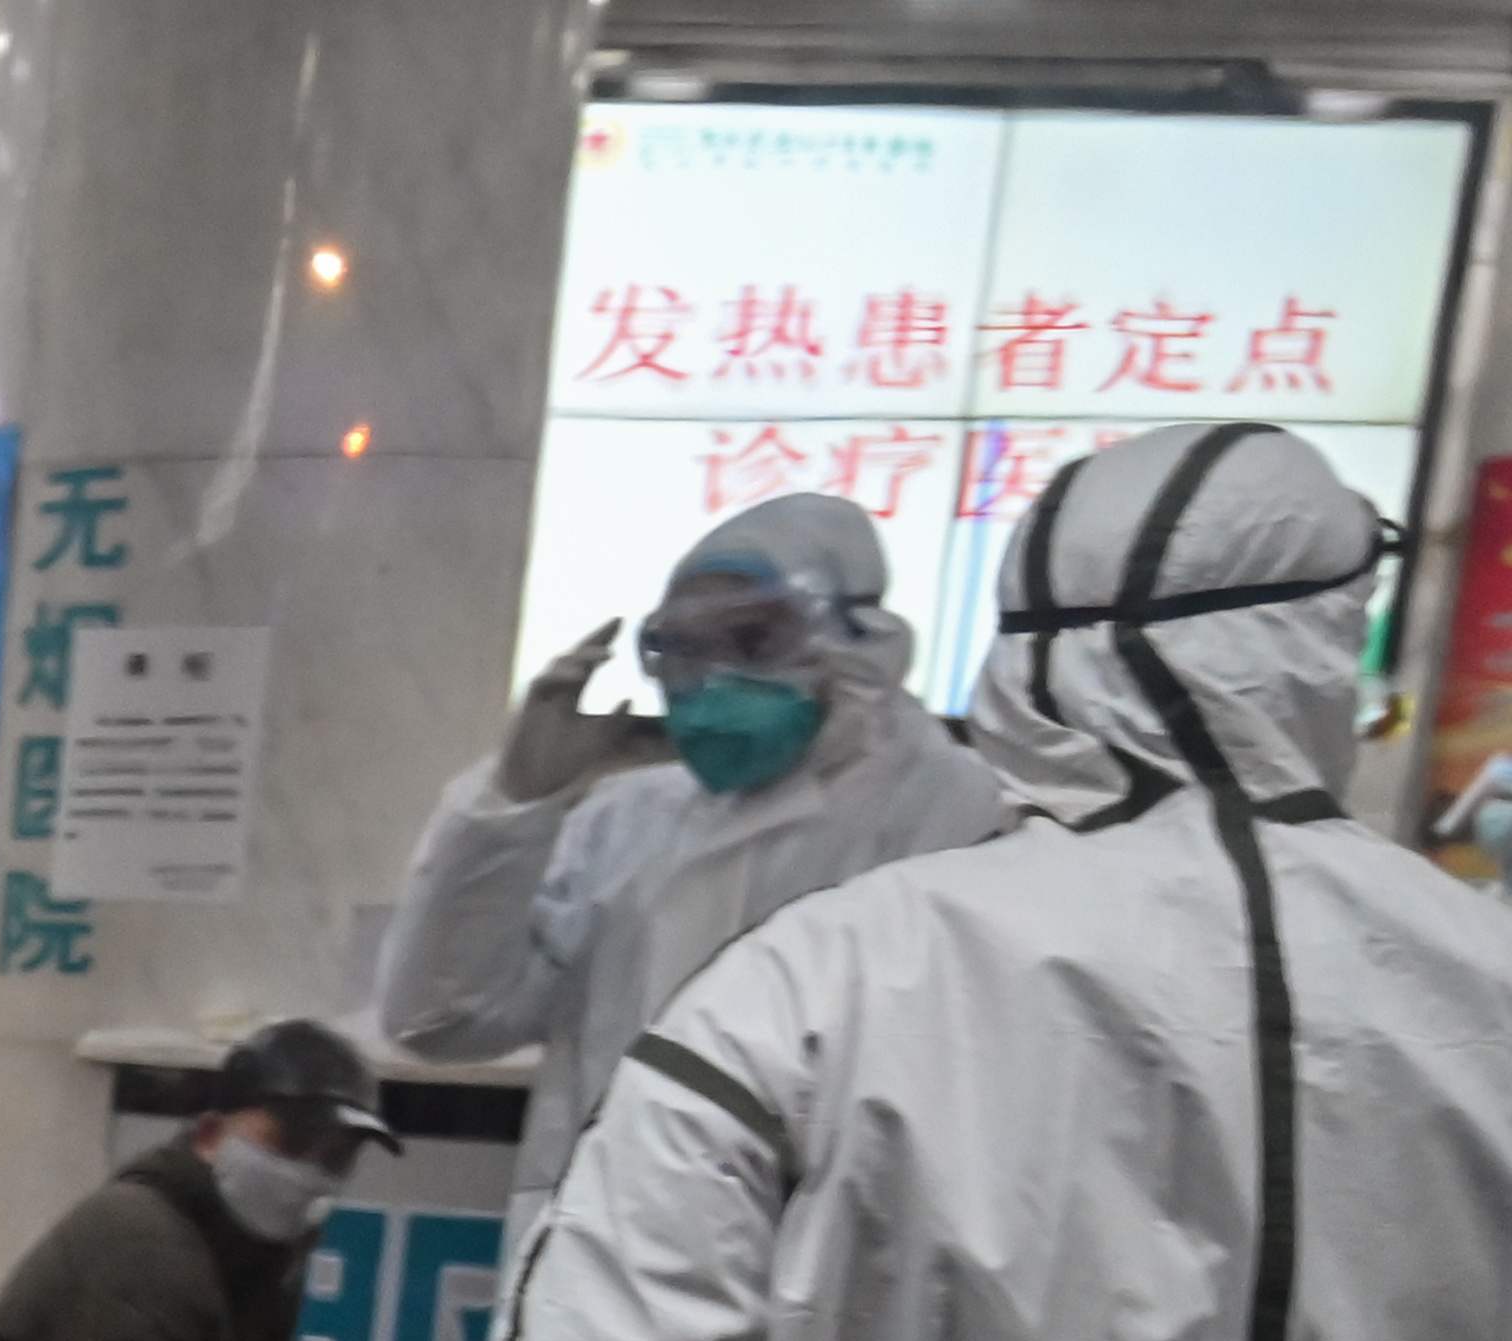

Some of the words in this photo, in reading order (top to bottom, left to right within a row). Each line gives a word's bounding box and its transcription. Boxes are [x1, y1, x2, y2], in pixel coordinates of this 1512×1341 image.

[572, 284, 1338, 394] 发热患者定点
[691, 424, 1140, 520] 诊疗医
